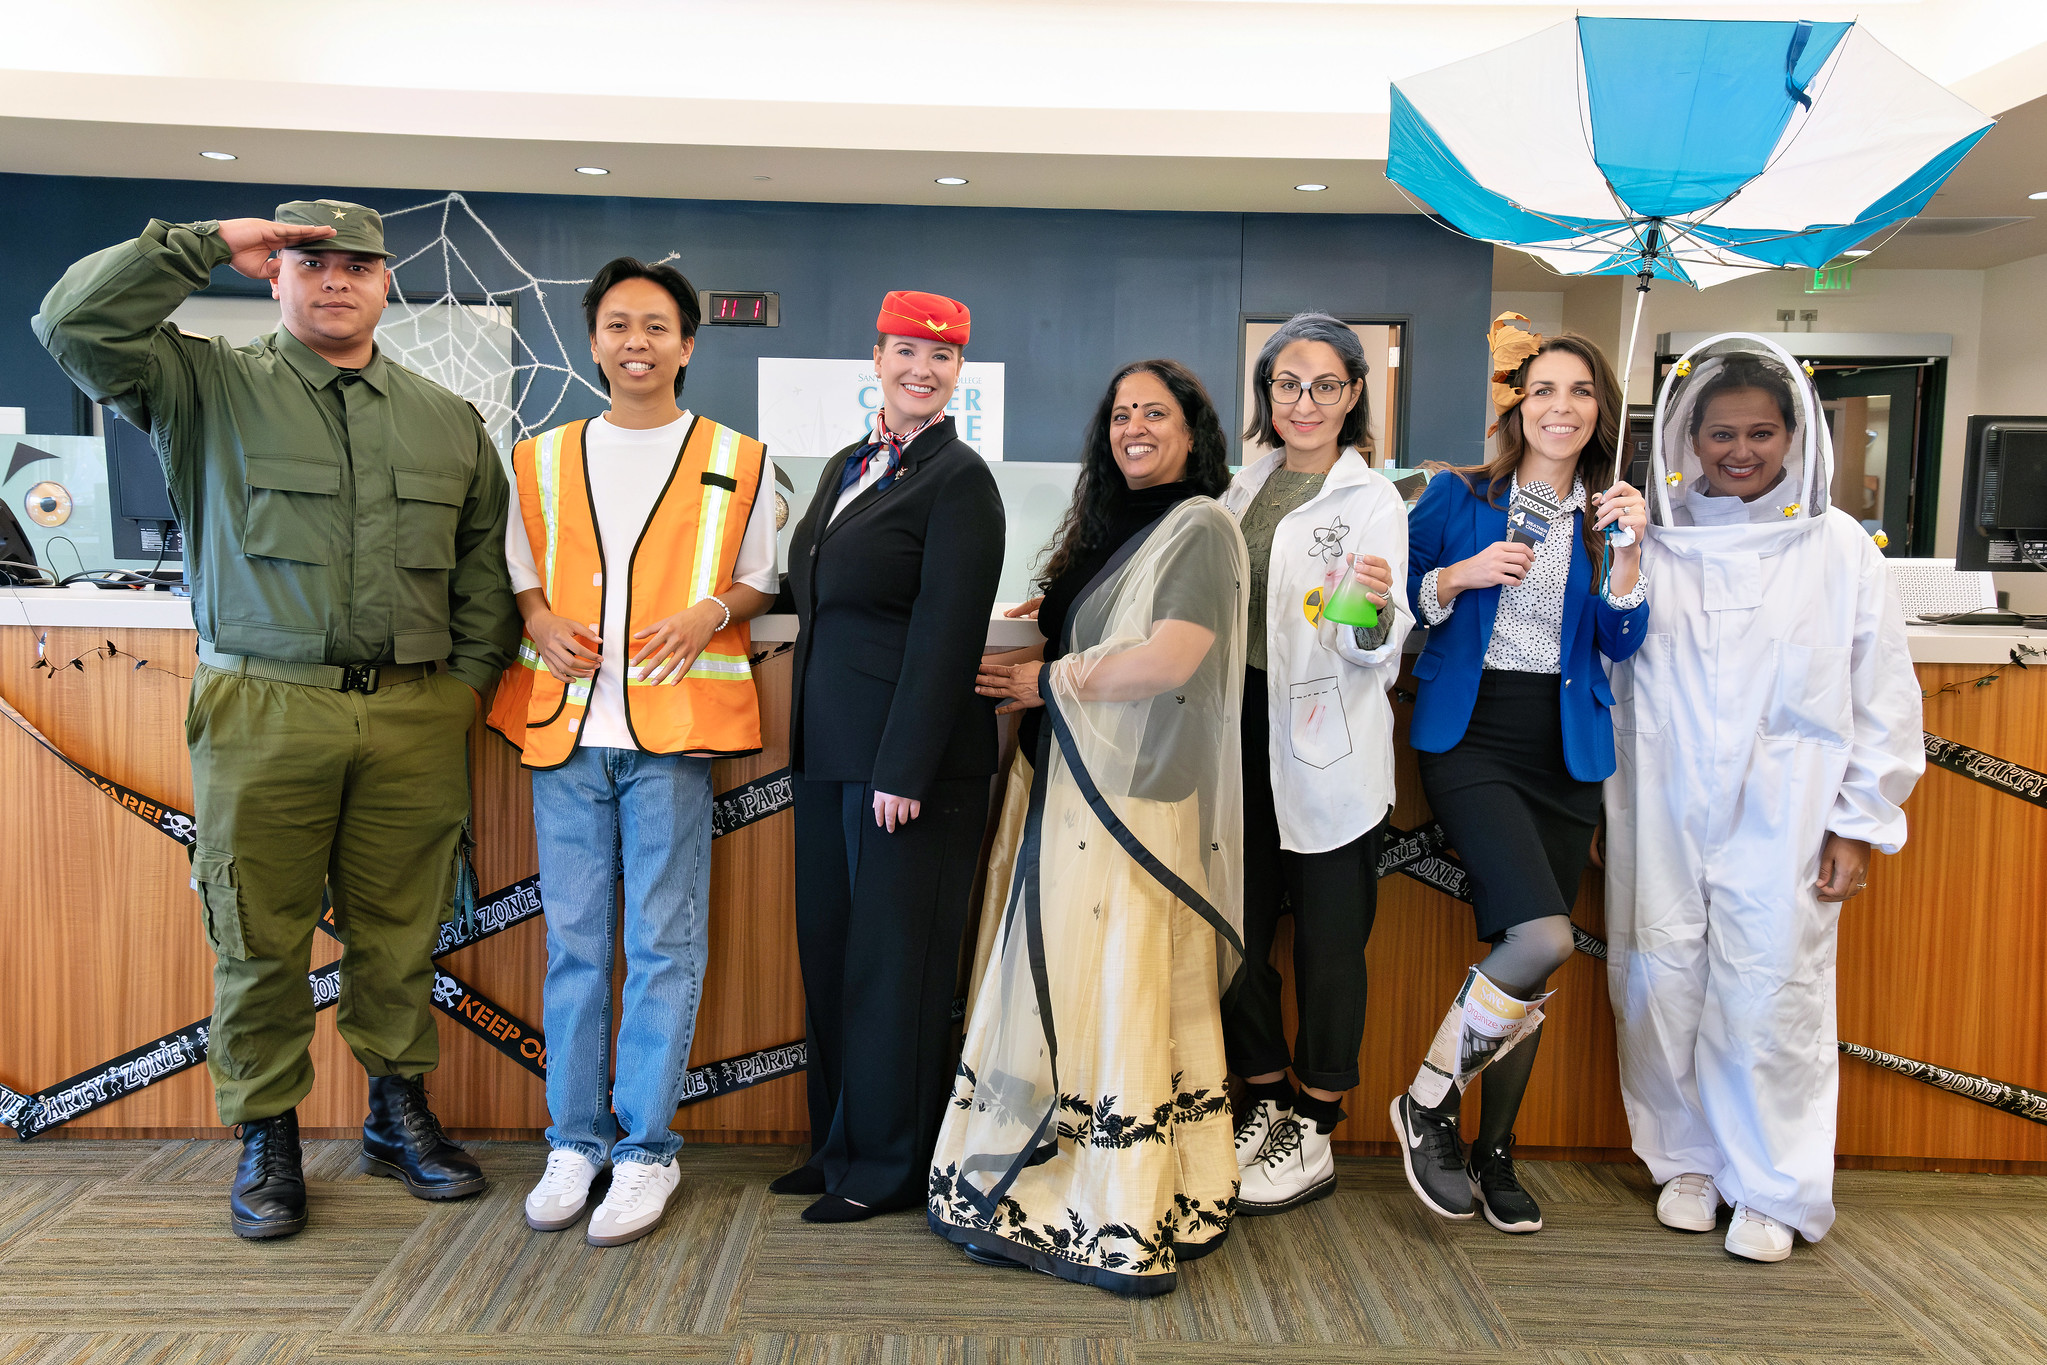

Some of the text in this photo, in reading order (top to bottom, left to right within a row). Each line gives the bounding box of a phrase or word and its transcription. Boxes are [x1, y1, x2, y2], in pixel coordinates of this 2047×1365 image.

[1511, 511, 1527, 527] 4
[1525, 525, 1546, 538] CHANNEL
[1526, 520, 1548, 534] WEATHER
[1965, 753, 2047, 798] PARTY
[738, 775, 793, 820] PART
[1405, 857, 1466, 892] ONE
[476, 886, 542, 934] ZONE
[456, 993, 521, 1042] KEEP
[1466, 1002, 1498, 1029] Organize
[735, 1043, 807, 1084] PARTY
[1848, 1043, 2001, 1104] PARTY ZONE
[34, 1041, 187, 1130] PARTY ZONE
